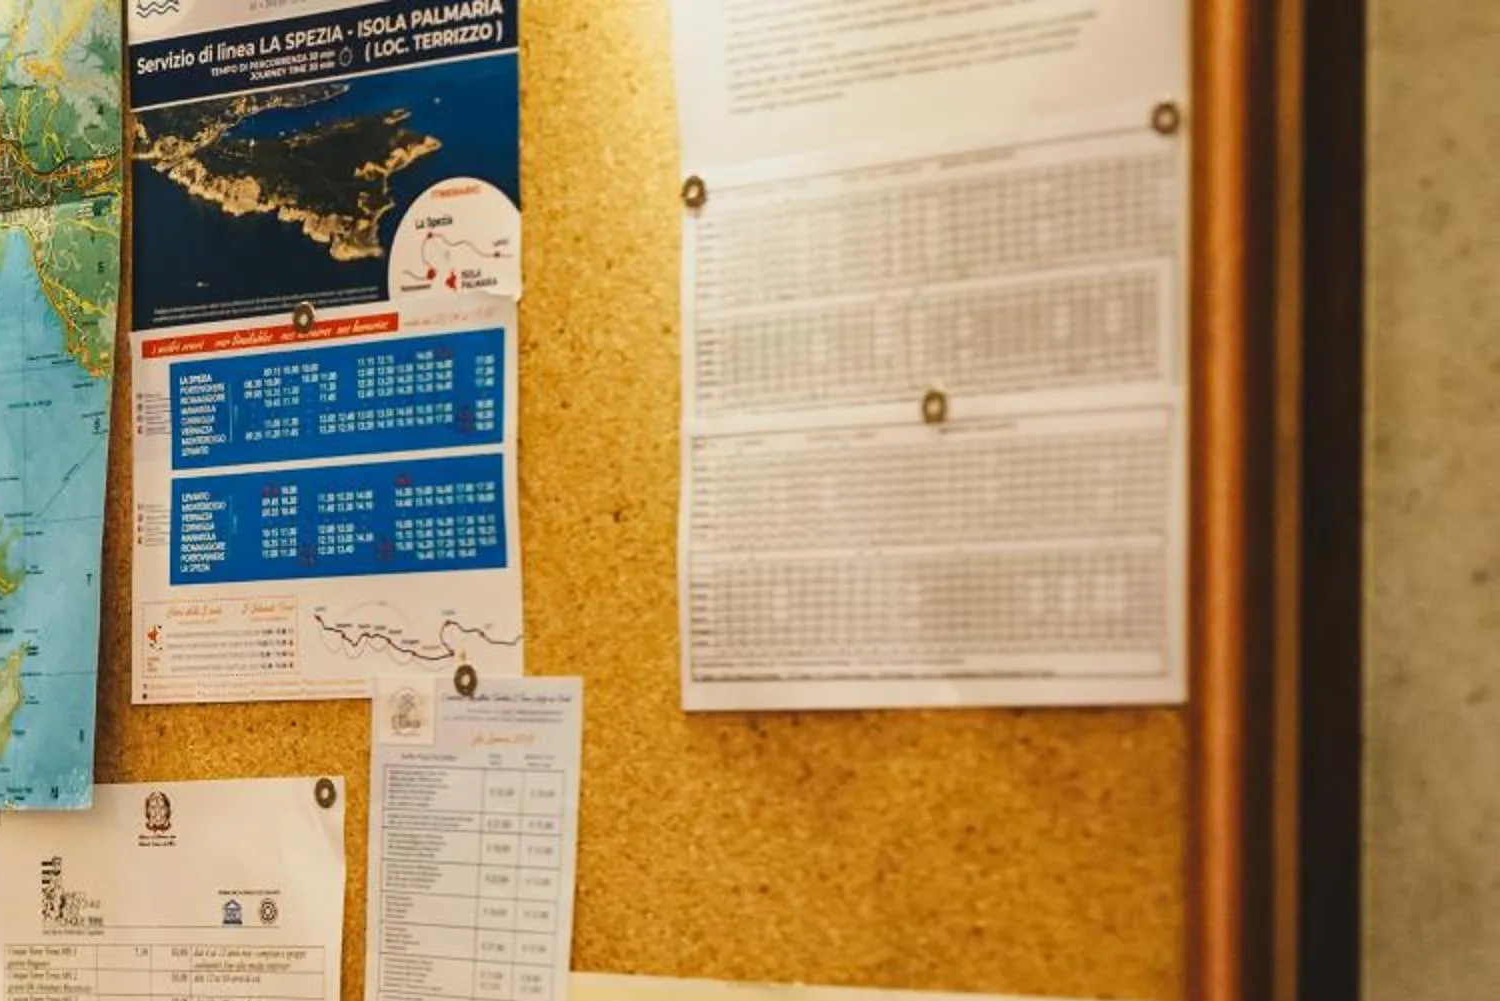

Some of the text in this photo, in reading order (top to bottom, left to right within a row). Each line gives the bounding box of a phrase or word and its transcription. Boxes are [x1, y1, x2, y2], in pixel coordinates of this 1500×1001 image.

[136, 49, 195, 75] Servizio
[198, 43, 214, 64] di
[216, 41, 255, 60] linea
[259, 35, 281, 55] LA
[284, 24, 343, 50] SPEZIA
[357, 14, 407, 38] ISOLA
[411, 0, 504, 28] PALMARIA
[374, 37, 409, 57] LOC.
[412, 23, 493, 51] TERRIZZO
